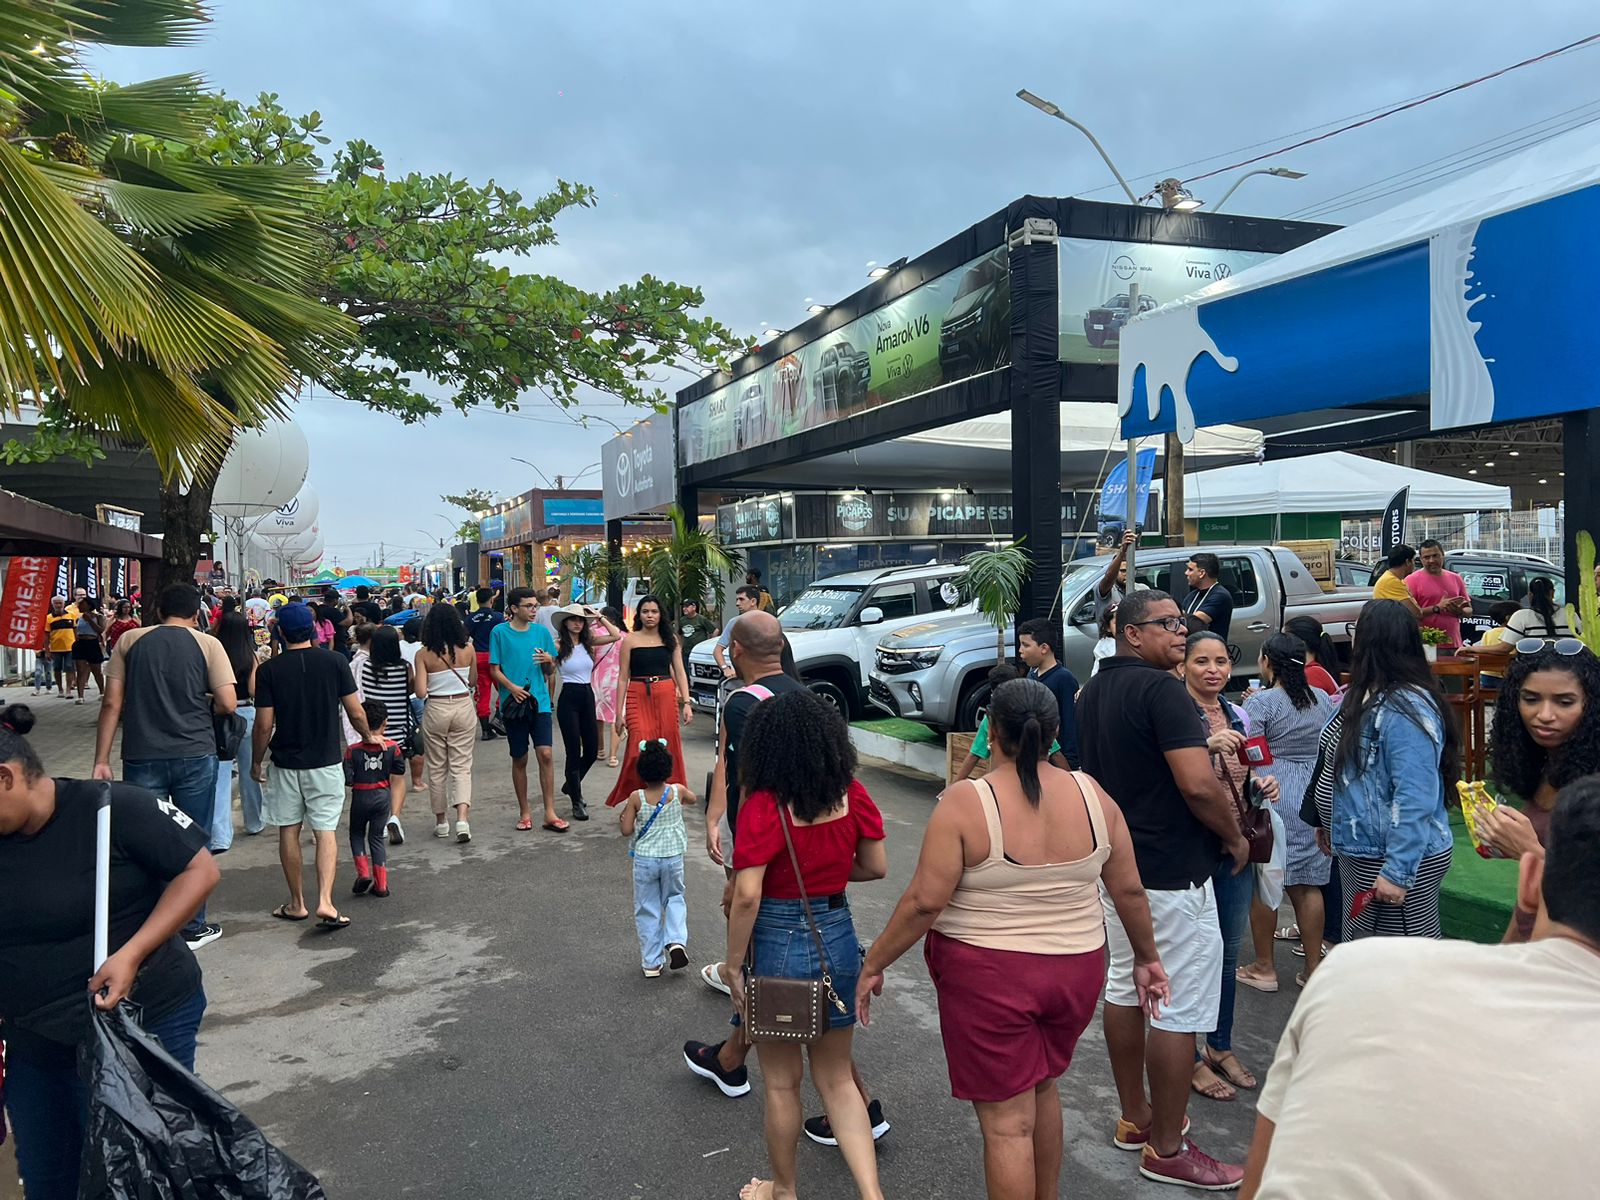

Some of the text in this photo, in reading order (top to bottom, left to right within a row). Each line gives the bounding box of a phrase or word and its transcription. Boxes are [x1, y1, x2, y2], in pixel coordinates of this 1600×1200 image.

[1186, 266, 1211, 279] Viva
[878, 320, 892, 333] Nova
[876, 313, 930, 355] Amarok V6
[886, 365, 902, 379] Viva
[633, 444, 653, 472] Toyota
[1106, 483, 1147, 494] SHK
[836, 505, 873, 519] PICAPES
[887, 507, 921, 522] SUA
[929, 506, 985, 521] PICAPE
[1391, 508, 1401, 548] OTORS
[1303, 561, 1323, 572] gro
[8, 556, 40, 644] SEMEAR
[819, 588, 850, 601] Shark
[1462, 617, 1491, 626] PARTIR
[696, 665, 721, 676] BYD
